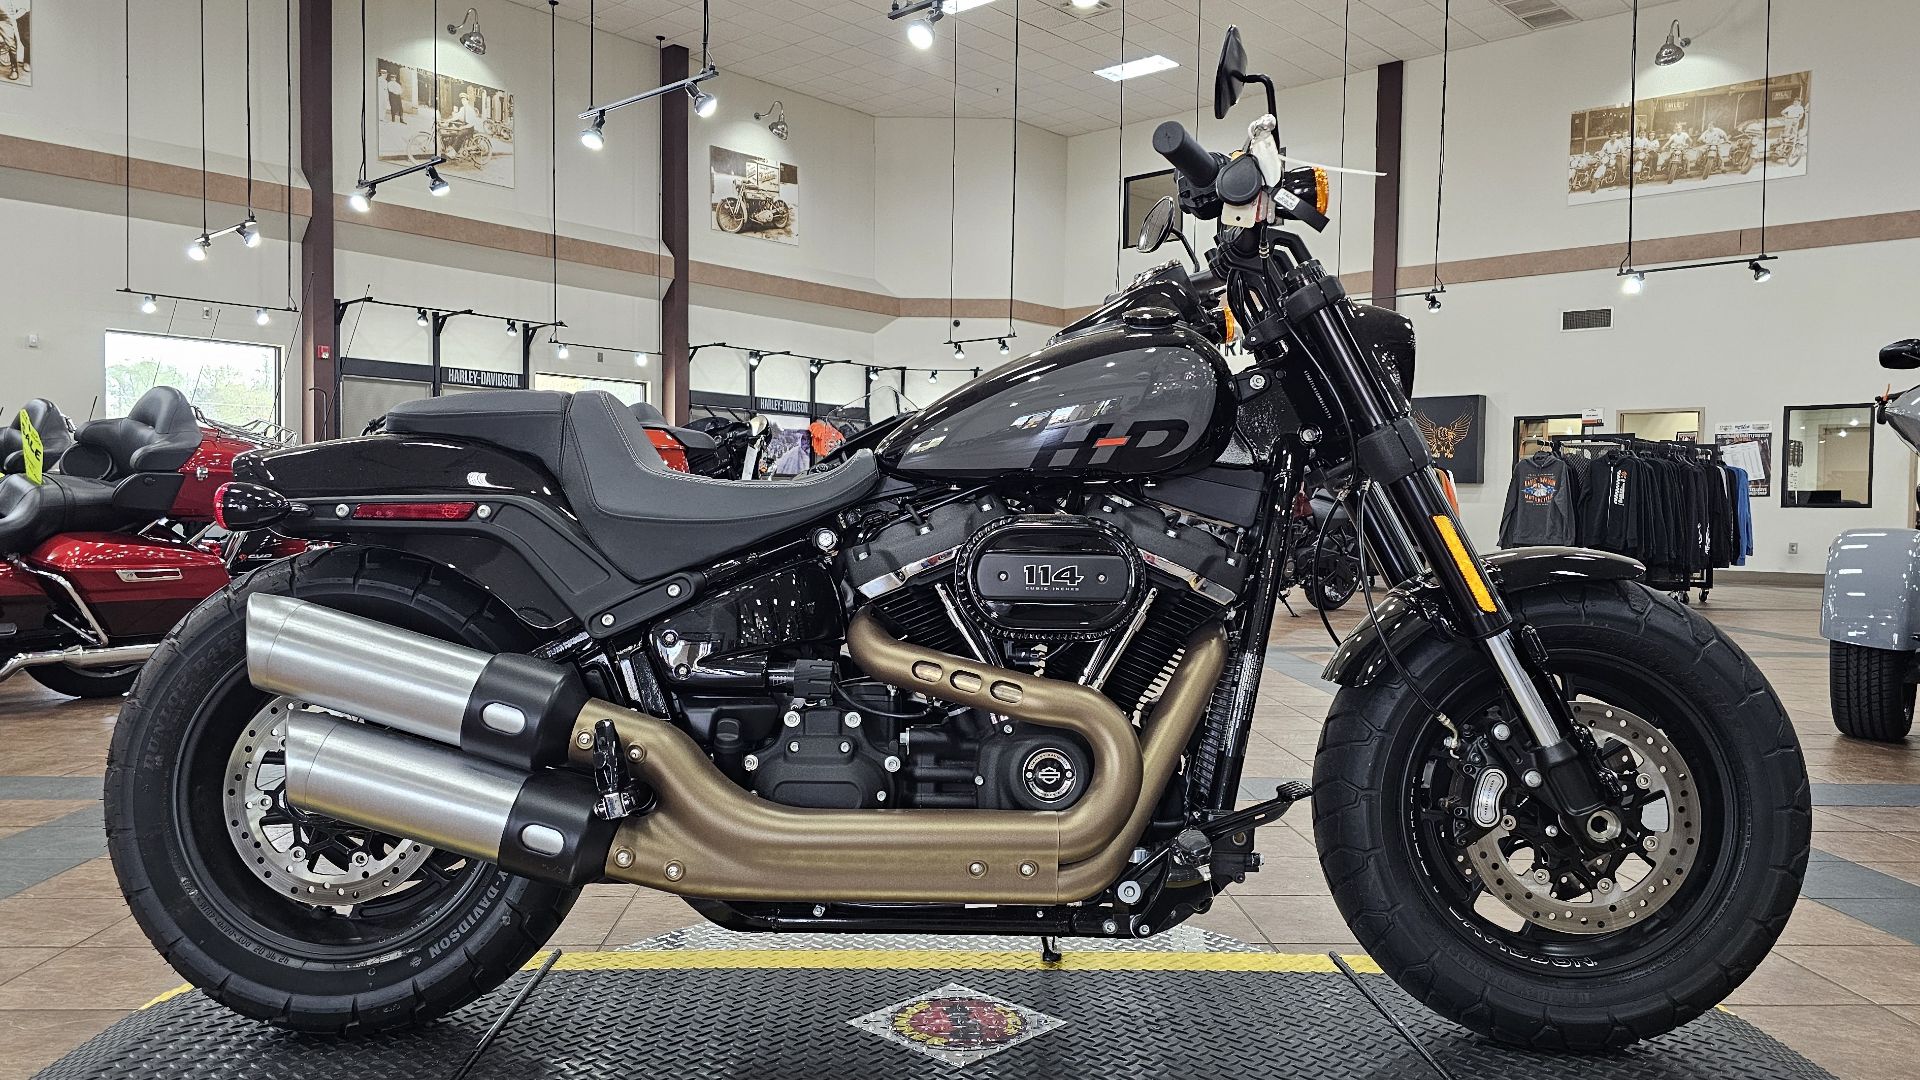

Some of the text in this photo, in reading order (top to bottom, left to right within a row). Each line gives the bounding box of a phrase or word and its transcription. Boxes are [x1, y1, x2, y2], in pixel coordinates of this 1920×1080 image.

[448, 368, 519, 388] HARLEY-DAVIDSON
[760, 398, 809, 413] HARLEY-DAVIDSON
[1023, 564, 1085, 586] 114
[428, 869, 510, 959] Y-DAVIDSON
